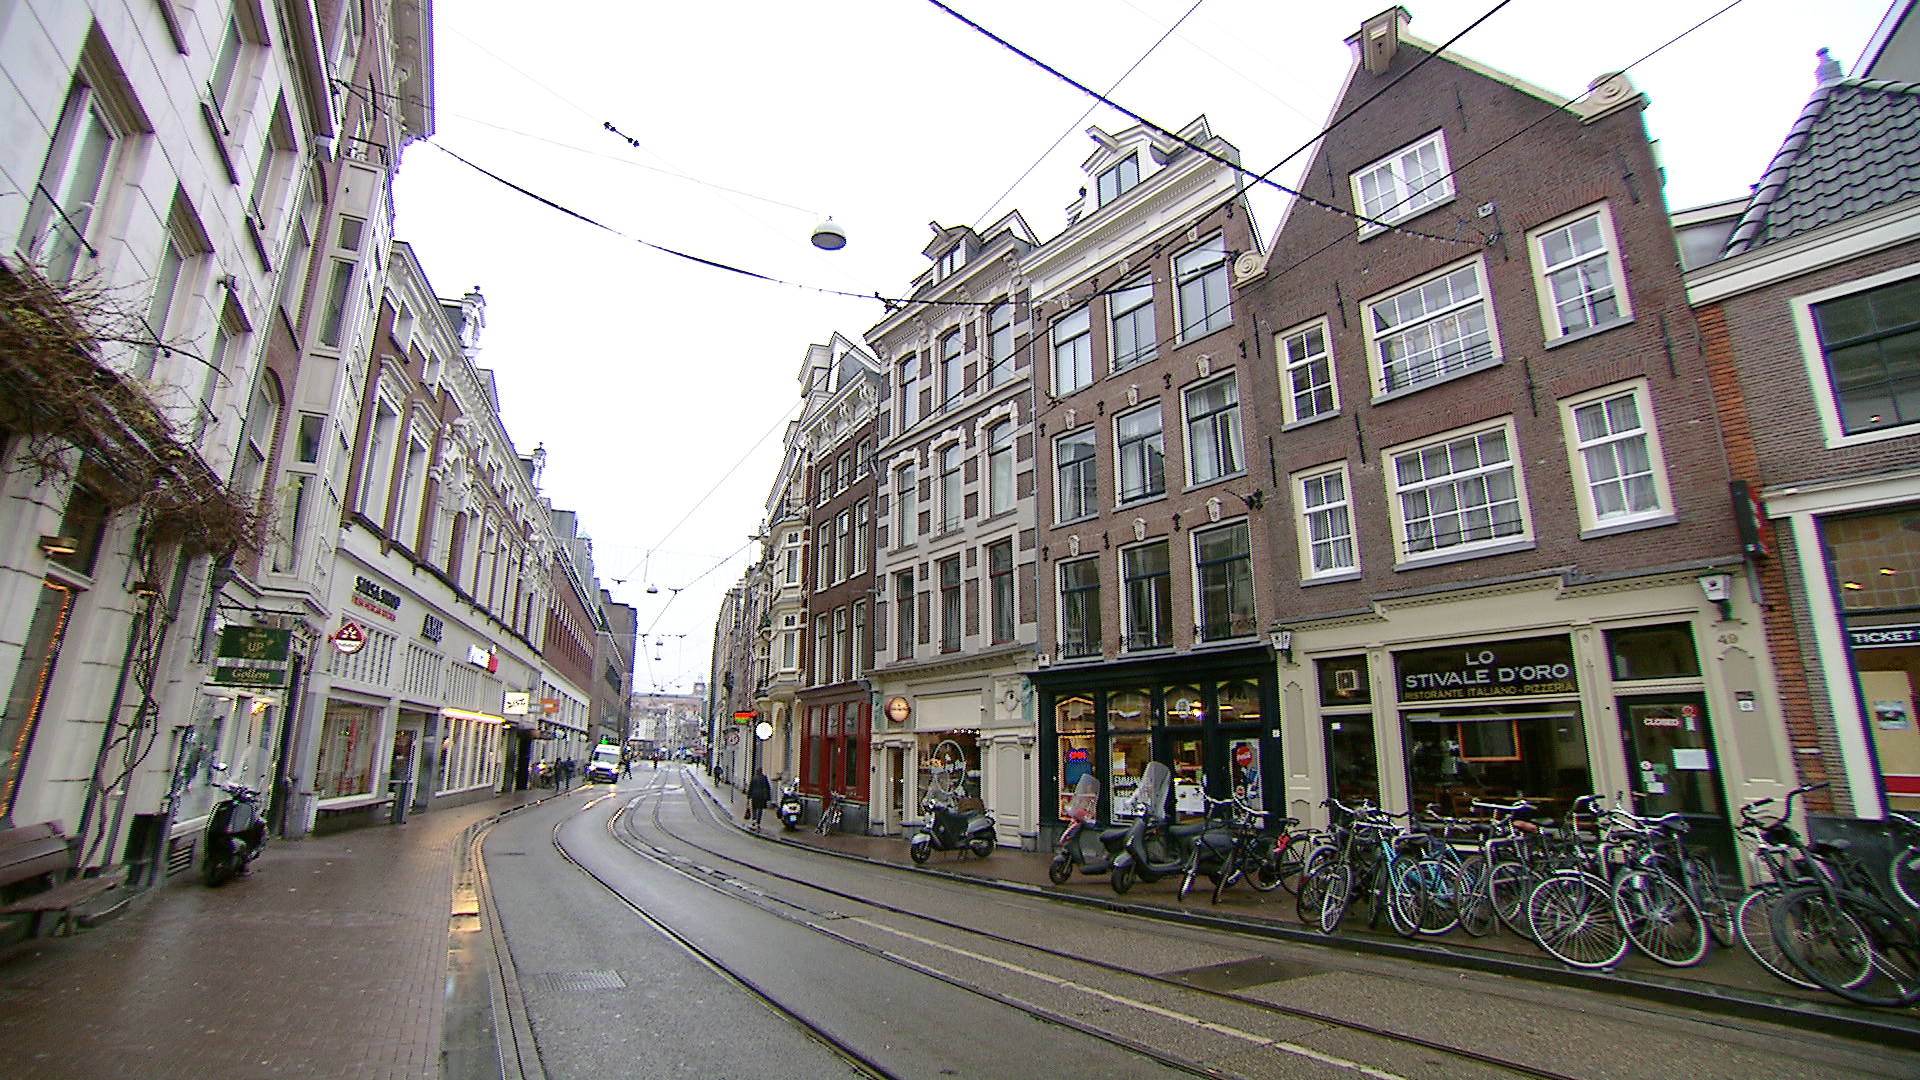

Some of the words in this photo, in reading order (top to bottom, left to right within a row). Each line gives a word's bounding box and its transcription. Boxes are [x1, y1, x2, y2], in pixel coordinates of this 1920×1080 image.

[1718, 633, 1738, 644] 49
[1465, 650, 1495, 666] LO
[1405, 669, 1491, 688] STIVALE
[1497, 663, 1569, 682] D'ORO
[1405, 688, 1464, 700] RISTORANTE
[1467, 685, 1517, 697] ITALIANO
[1523, 682, 1576, 694] PIZZERIA
